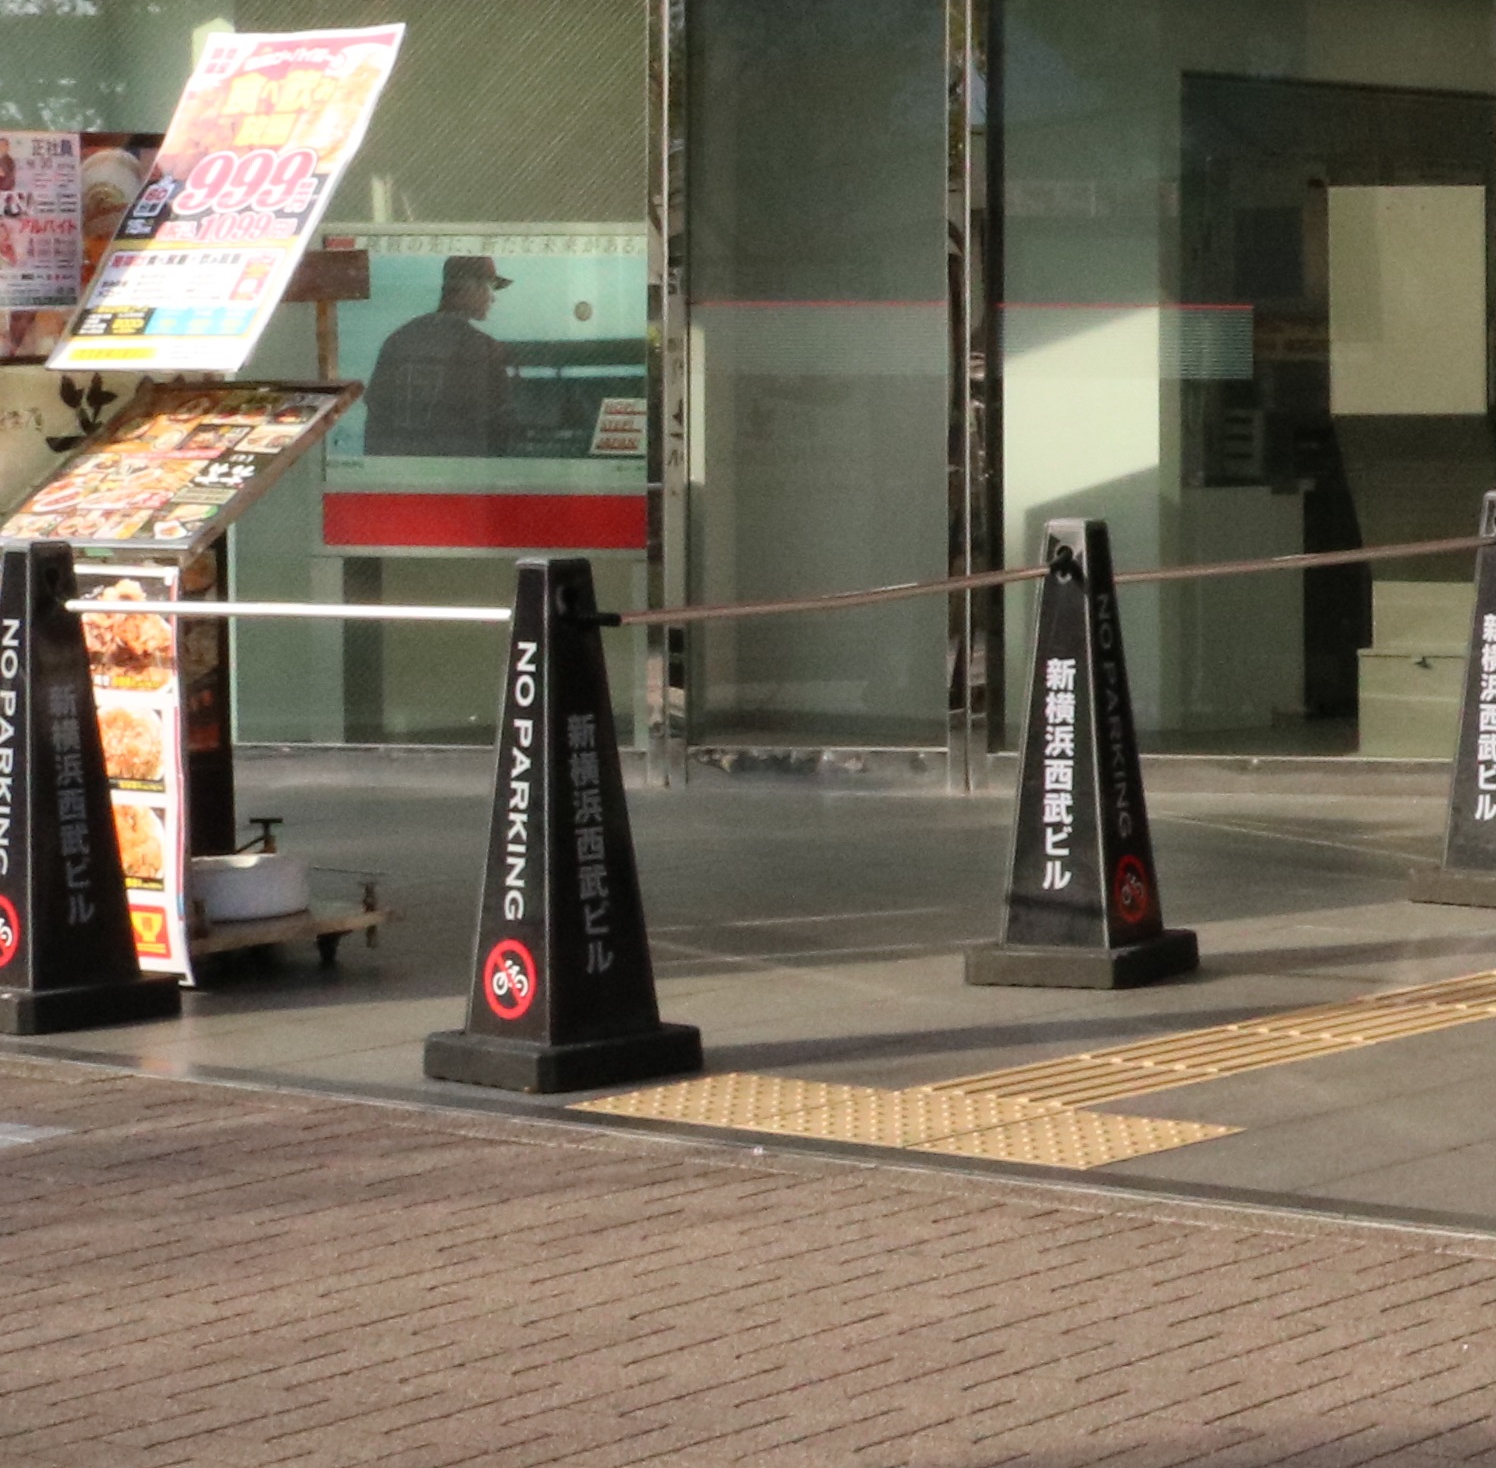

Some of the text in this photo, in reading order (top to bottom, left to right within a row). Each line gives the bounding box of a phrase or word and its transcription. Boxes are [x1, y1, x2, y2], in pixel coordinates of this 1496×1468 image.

[173, 148, 318, 215] 999
[0, 619, 20, 678] NO
[503, 641, 537, 921] NO PARKING
[1042, 658, 1076, 891] 新横浜西武ビル
